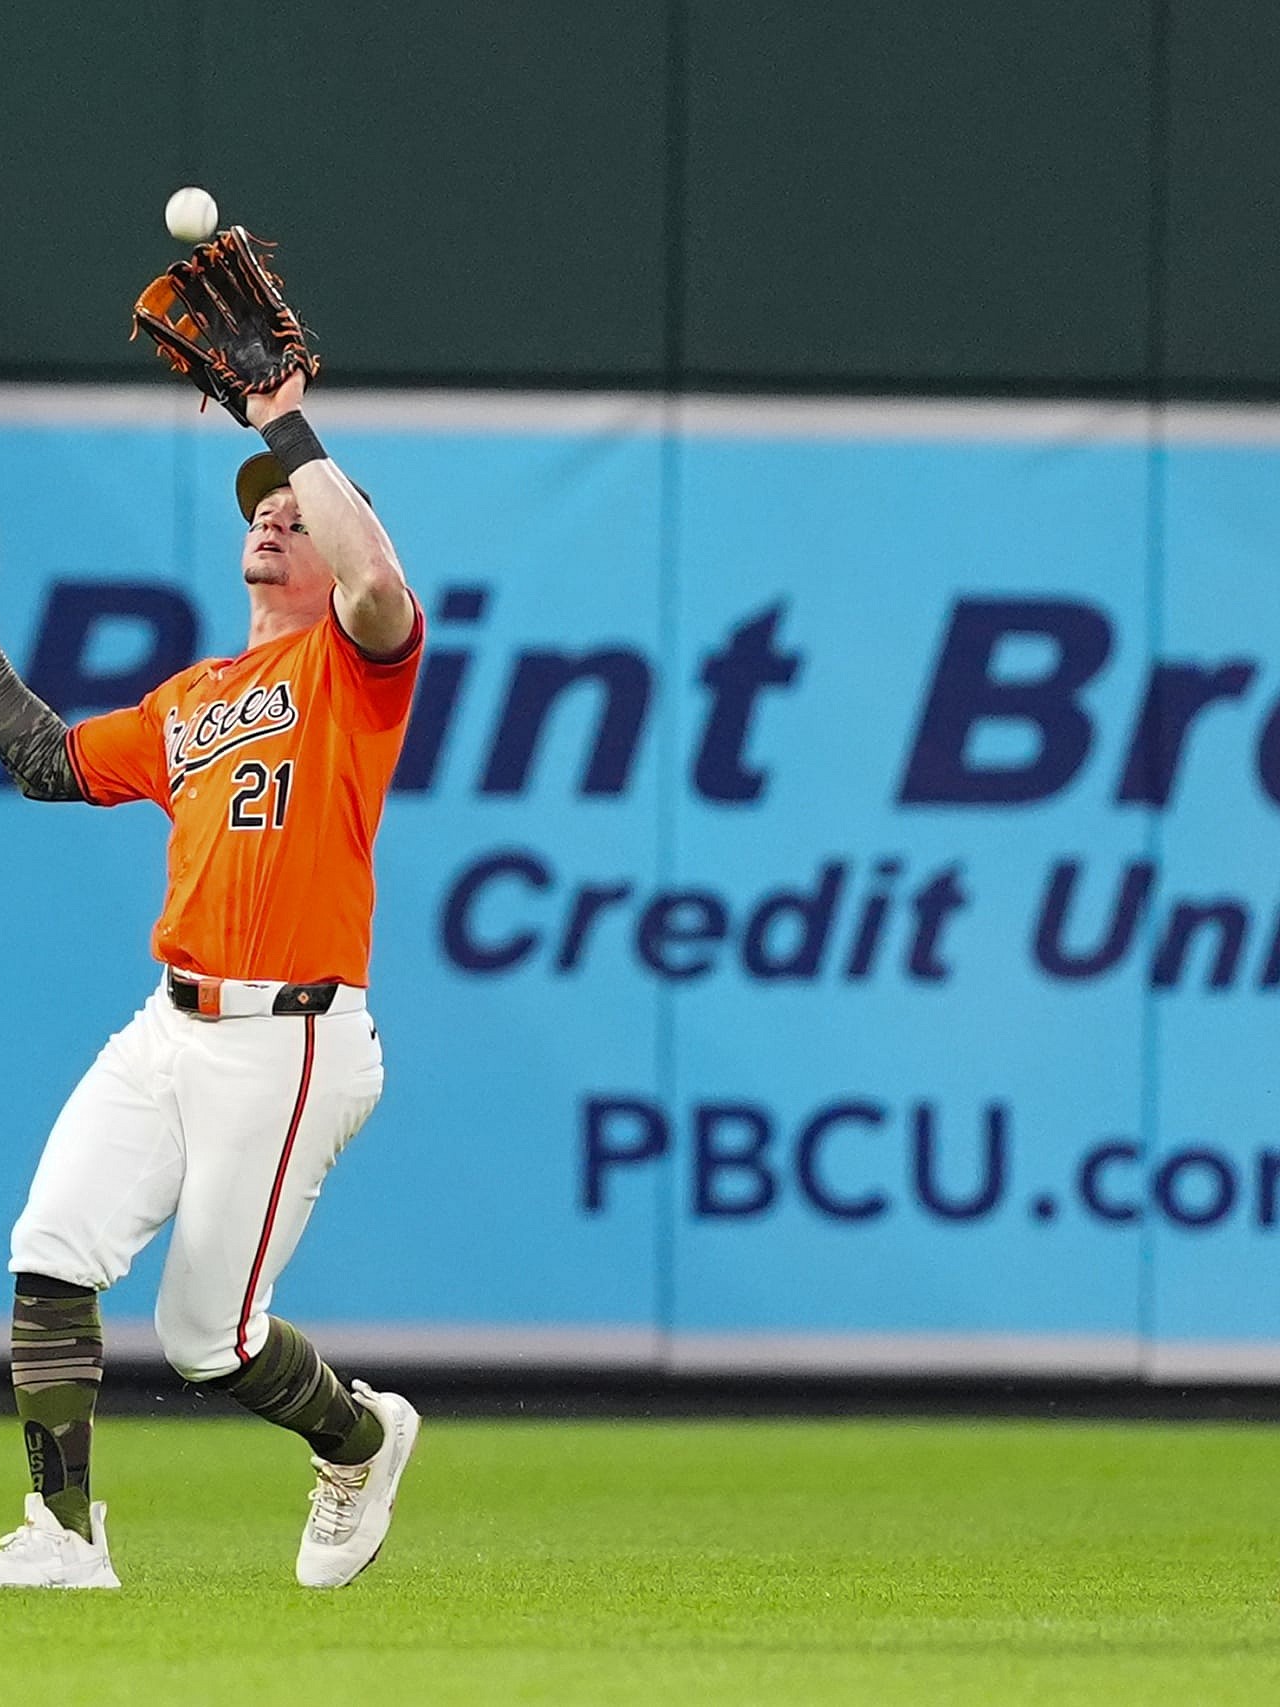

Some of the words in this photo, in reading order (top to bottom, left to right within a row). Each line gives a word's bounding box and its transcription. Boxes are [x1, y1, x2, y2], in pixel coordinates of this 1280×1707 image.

[163, 681, 298, 794] roes
[890, 594, 1280, 813] Br
[229, 760, 294, 830] 21
[436, 848, 966, 984] Credit
[579, 1093, 1280, 1230] PBCU.co
